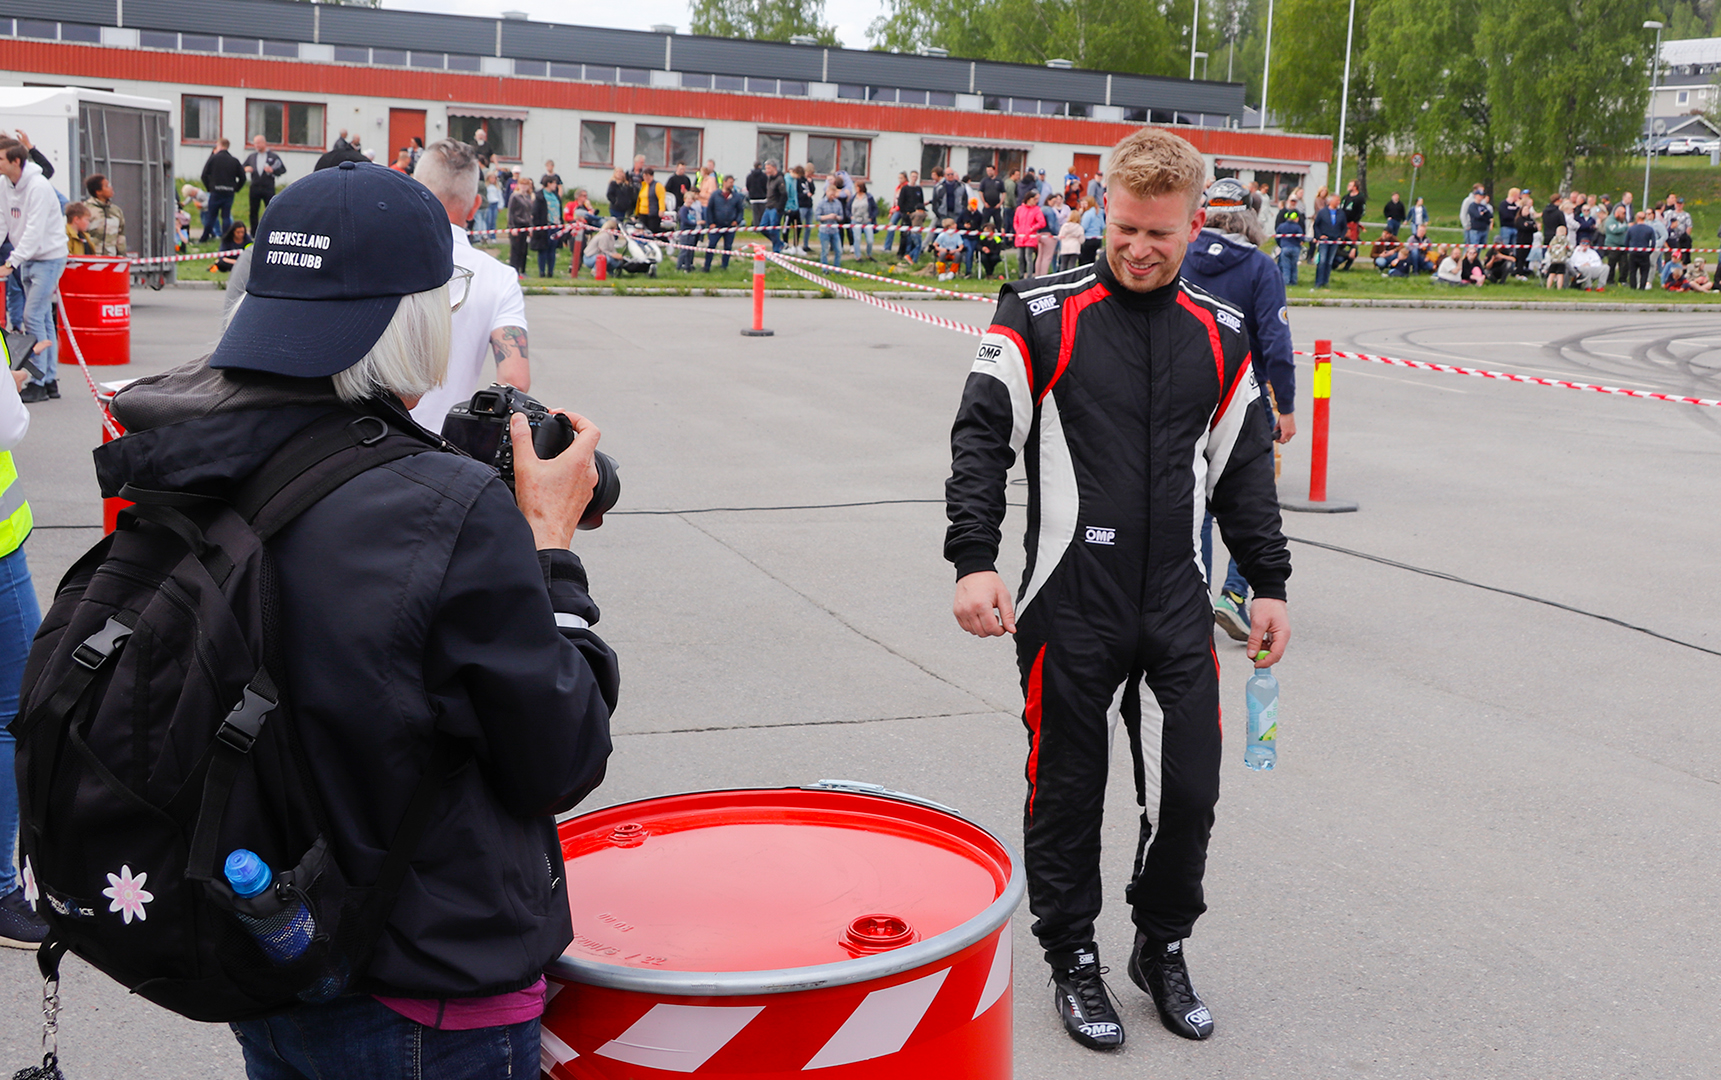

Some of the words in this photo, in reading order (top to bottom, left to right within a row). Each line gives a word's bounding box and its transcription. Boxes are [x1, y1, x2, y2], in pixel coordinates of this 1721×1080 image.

[268, 231, 331, 250] GRENSELAND
[266, 250, 322, 269] FOTOKLUBB
[102, 304, 131, 317] RET
[1028, 296, 1057, 314] OMP
[1217, 311, 1241, 329] OMP
[978, 345, 1002, 360] OMP
[1085, 529, 1116, 543] OMP
[1189, 1008, 1213, 1024] OM
[1080, 1024, 1118, 1037] OMP
